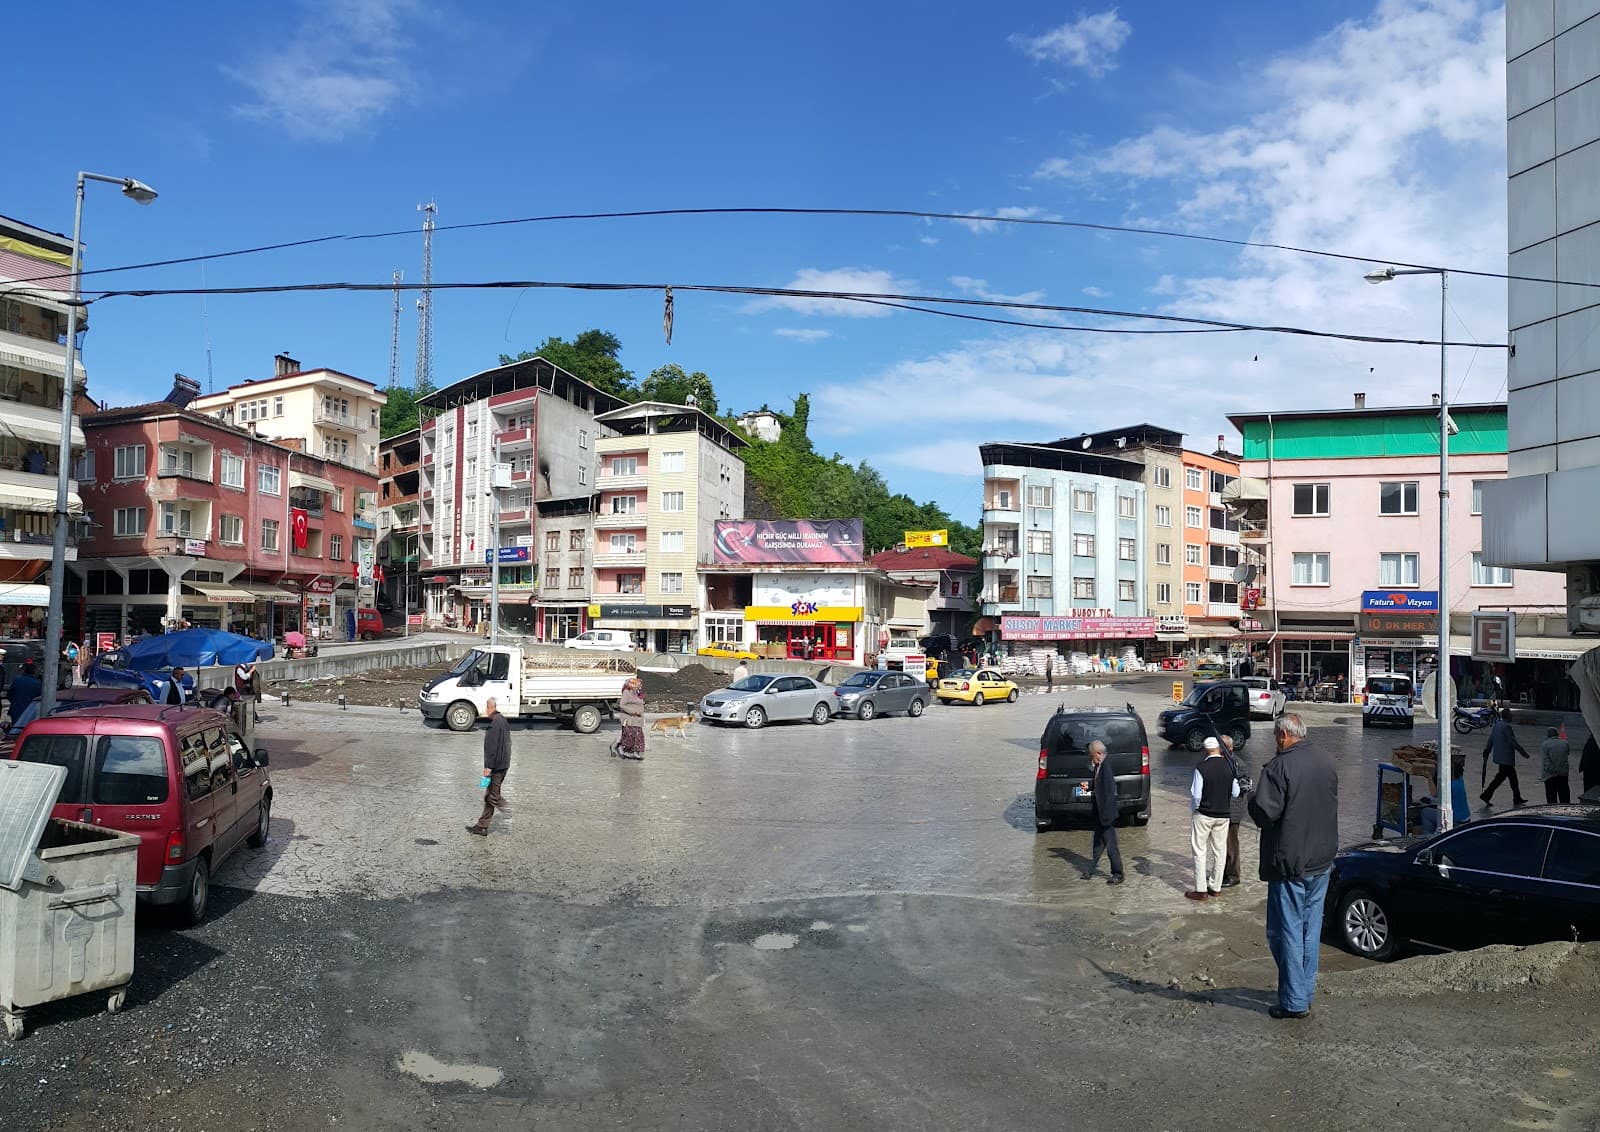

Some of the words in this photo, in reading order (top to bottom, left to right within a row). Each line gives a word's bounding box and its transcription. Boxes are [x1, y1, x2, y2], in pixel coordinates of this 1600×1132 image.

[791, 601, 819, 617] ŞOK
[1369, 598, 1395, 607] Fatura
[1407, 598, 1433, 608] Vizyon
[1072, 608, 1097, 618] SUSOY
[1005, 618, 1040, 631] SUSOY
[1043, 618, 1082, 631] MARKET
[1481, 622, 1502, 651] E
